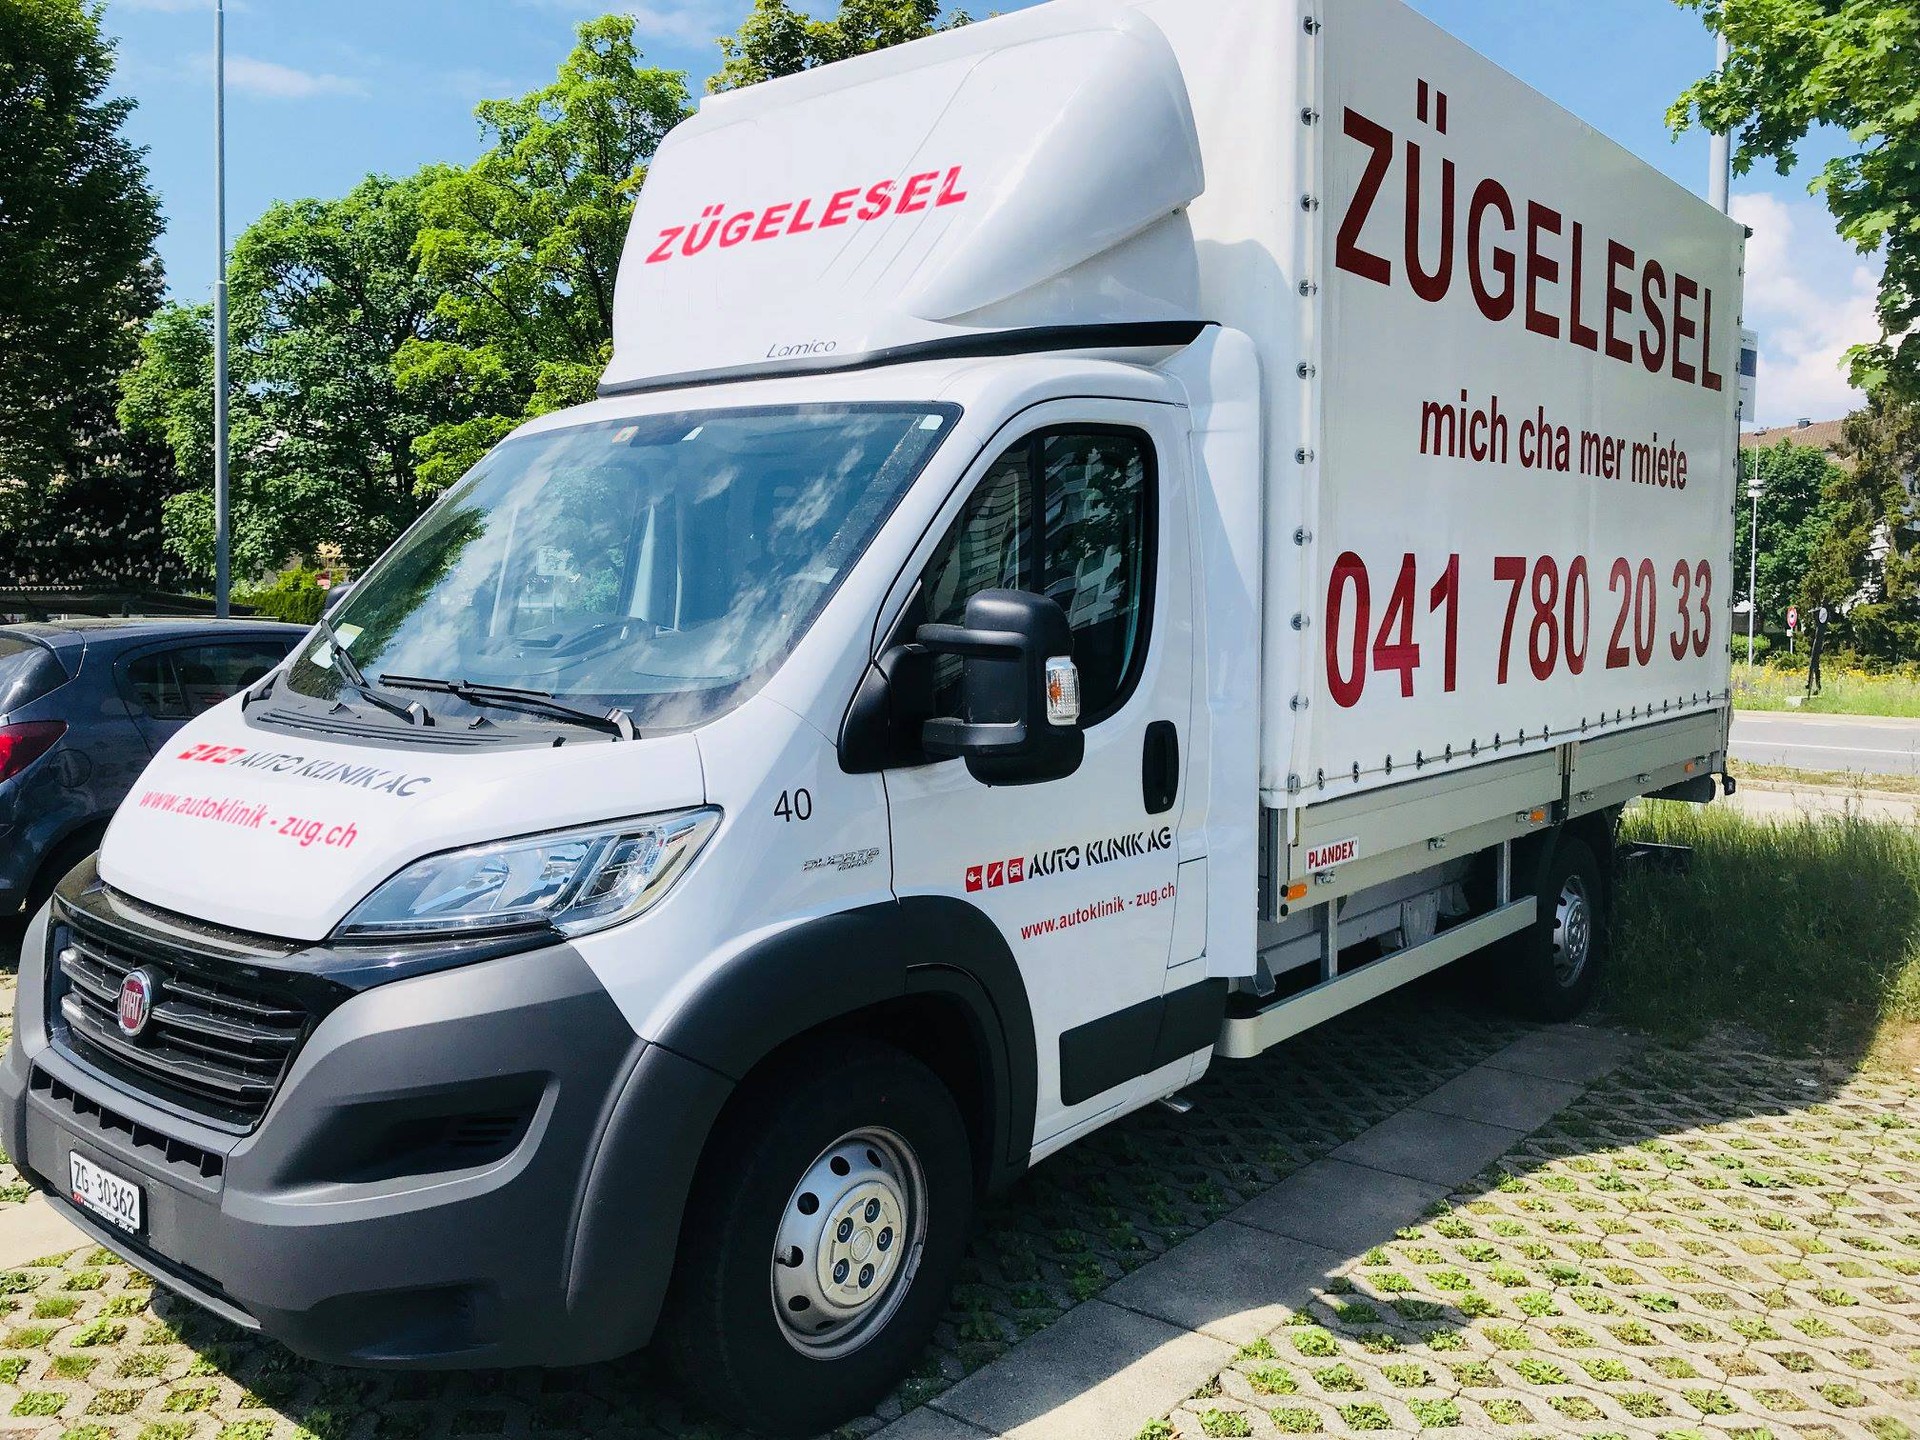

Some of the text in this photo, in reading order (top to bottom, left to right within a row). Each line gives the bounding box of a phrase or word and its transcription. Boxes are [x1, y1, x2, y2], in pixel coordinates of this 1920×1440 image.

[645, 165, 968, 264] ZÜGELESEL
[1335, 78, 1722, 391] ZÜGELESEL
[766, 339, 837, 358] Lamico
[1420, 389, 1688, 490] mich cha mer miete
[1325, 551, 1712, 708] 041 780 20 33
[230, 751, 304, 772] AUTO
[292, 759, 392, 788] KLINIK
[139, 791, 269, 829] www.autoklinik
[278, 815, 359, 848] zug.ch
[773, 788, 813, 823] 40
[1028, 826, 1172, 880] AUTO KLINIK AG
[1308, 841, 1355, 870] PLANDEX
[1020, 896, 1125, 940] www.autoklinik
[1136, 882, 1175, 907] zug.ch
